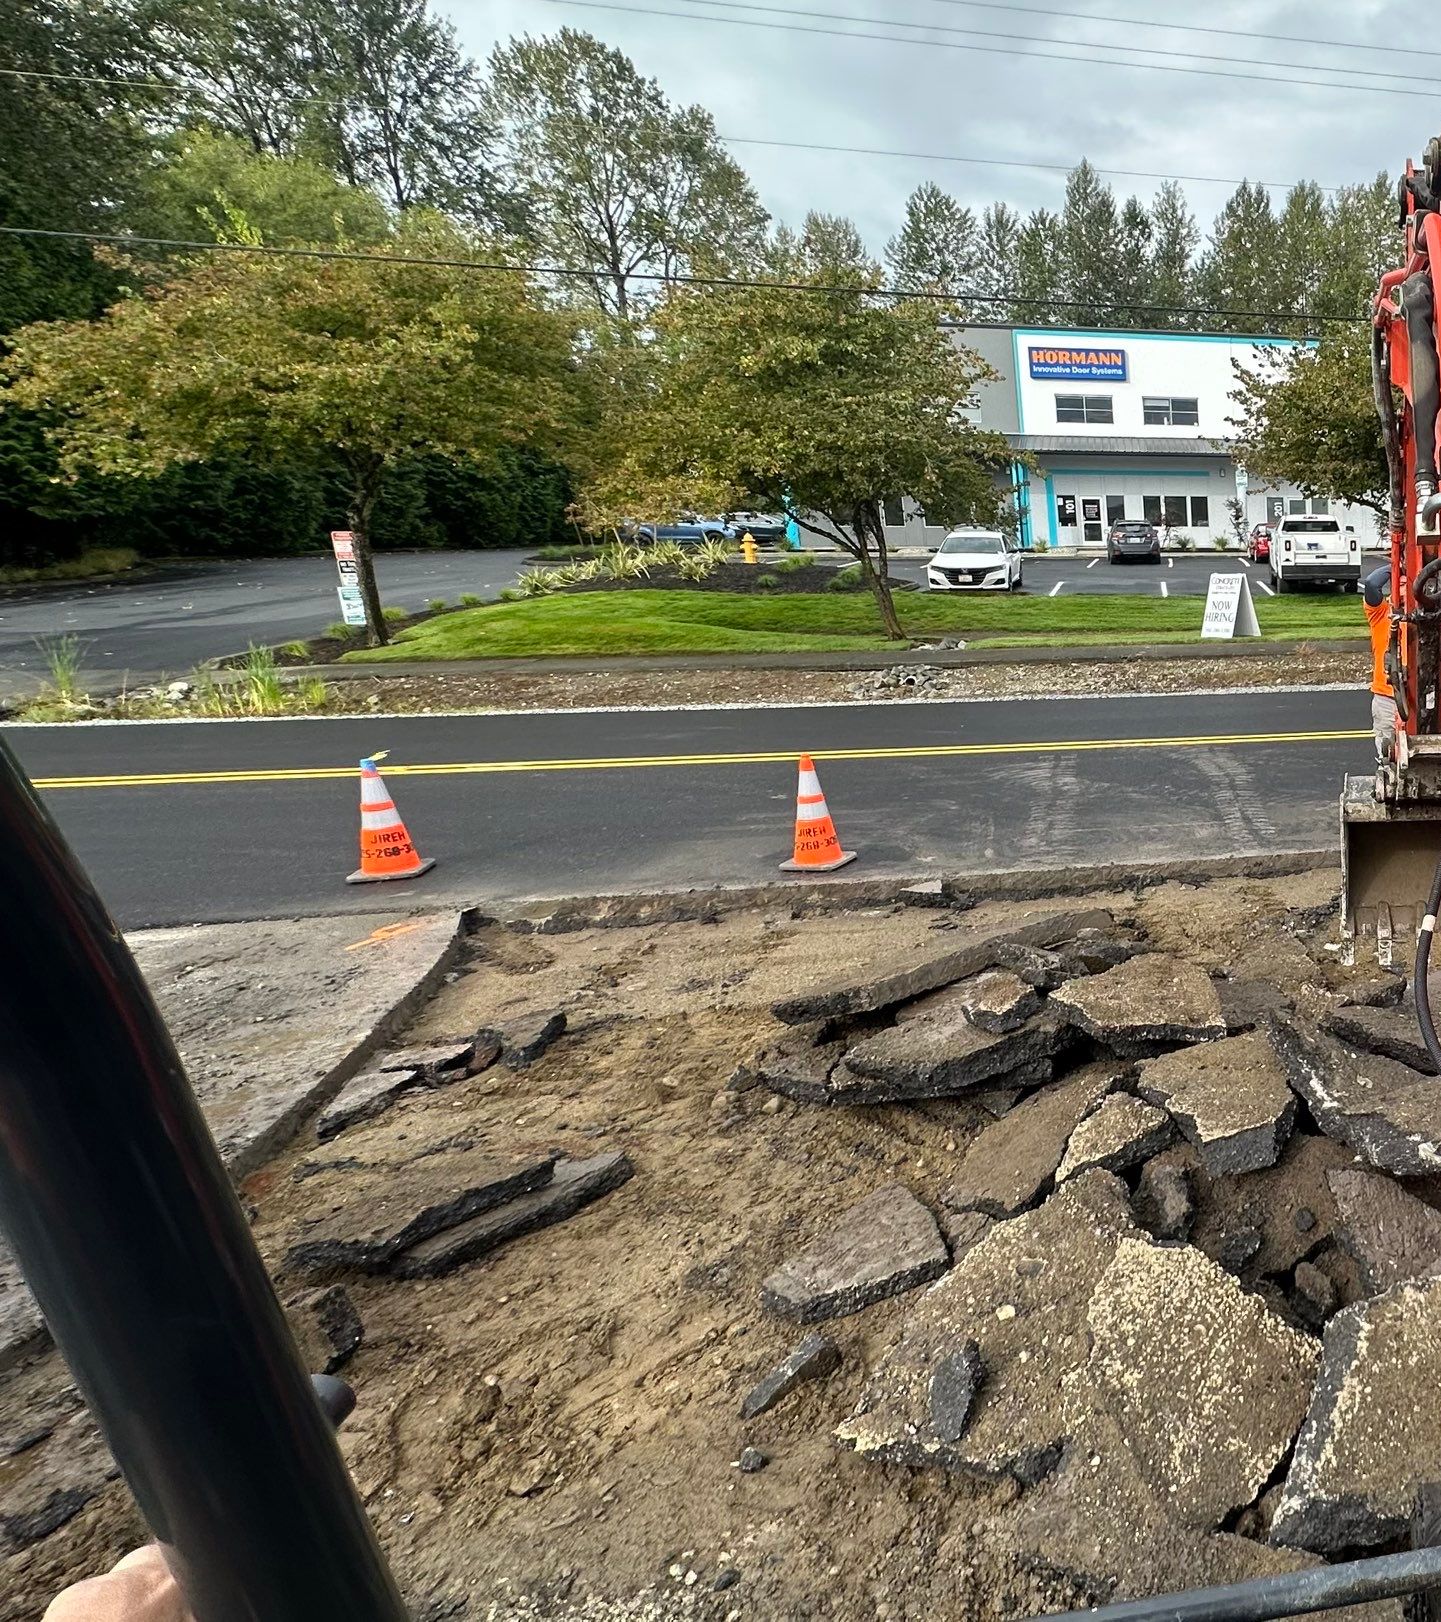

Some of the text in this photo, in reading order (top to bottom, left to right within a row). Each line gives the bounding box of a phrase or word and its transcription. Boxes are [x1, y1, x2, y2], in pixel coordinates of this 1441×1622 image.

[1033, 366, 1123, 375] Innovative Door Systems
[1065, 500, 1075, 514] 101
[1274, 502, 1283, 517] 201
[1211, 600, 1231, 610] NOW
[1205, 612, 1234, 622] HIRING
[371, 832, 405, 844] JIREH
